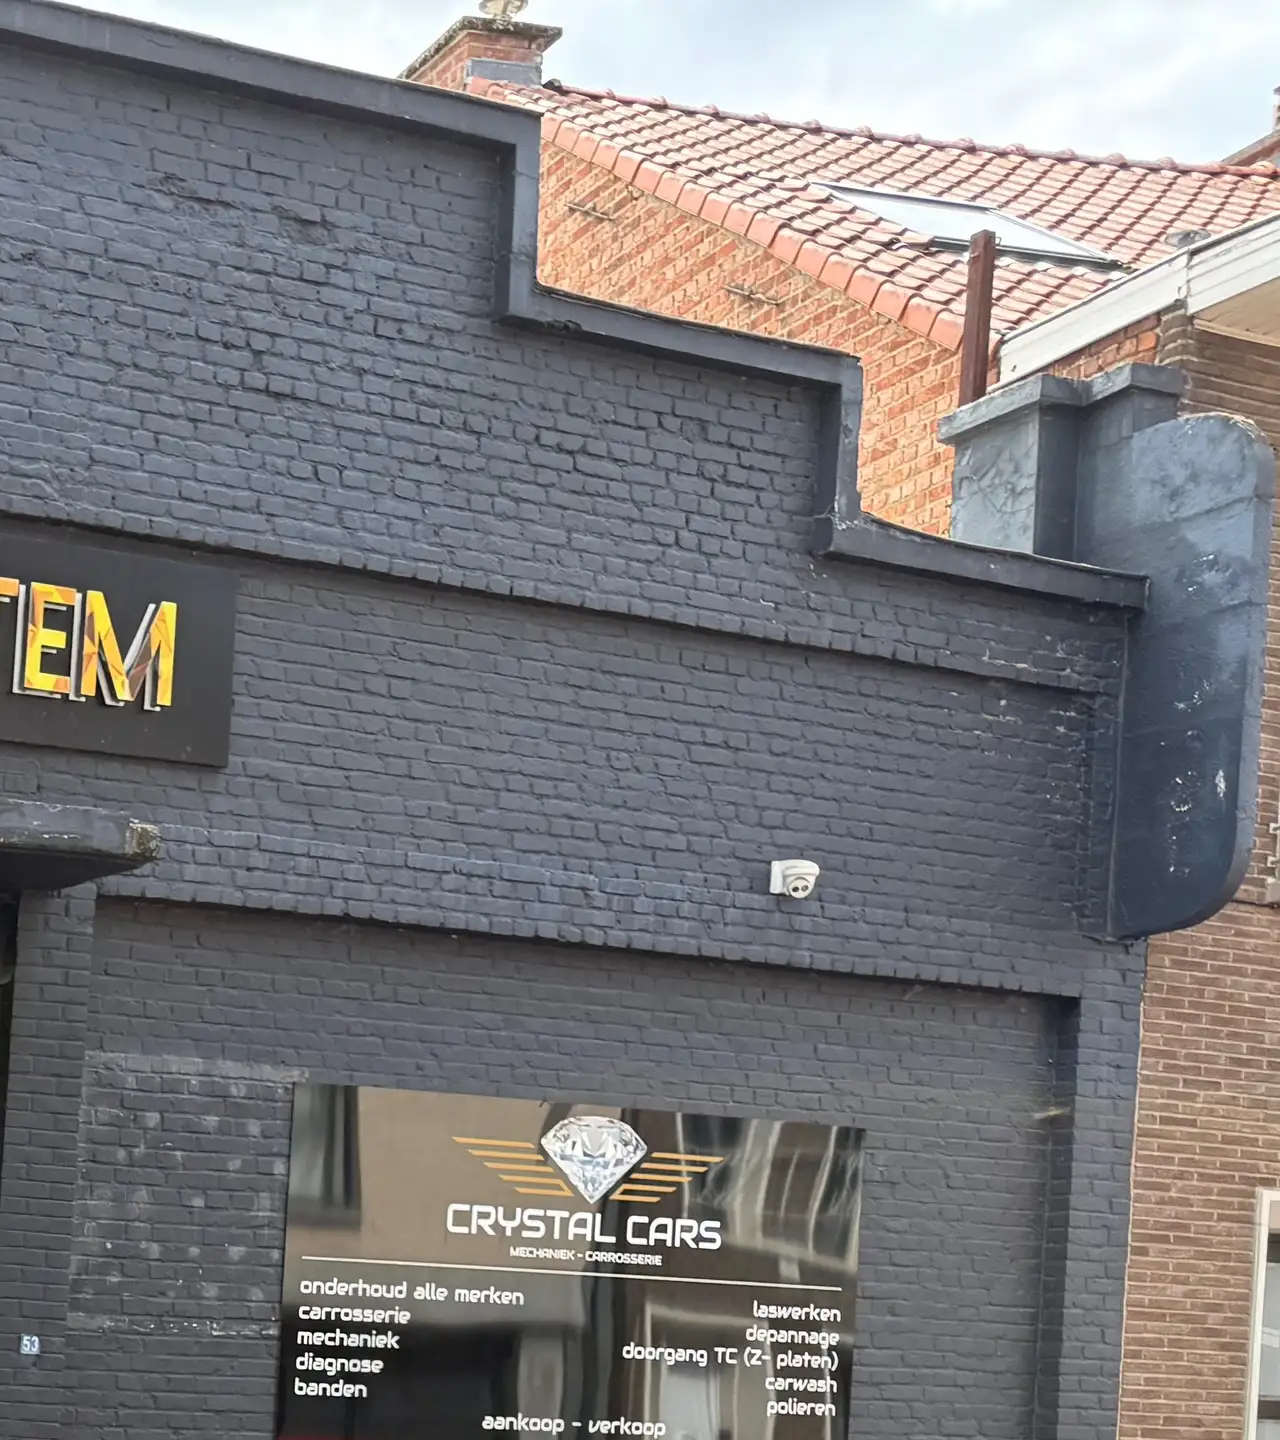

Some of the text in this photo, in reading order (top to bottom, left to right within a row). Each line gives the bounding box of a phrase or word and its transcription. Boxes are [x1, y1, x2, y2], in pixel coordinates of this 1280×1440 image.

[446, 1203, 722, 1250] CRYSTAL CARS
[509, 1246, 575, 1261] MECHANIEK
[585, 1250, 663, 1266] CARROSSERIE
[299, 1278, 524, 1305] onderhoud alle merken
[298, 1305, 411, 1324] carrosserie
[753, 1300, 841, 1322] laswerken
[22, 1335, 40, 1352] 53
[297, 1328, 400, 1349] mechaniek
[746, 1324, 840, 1350] depannage
[295, 1352, 384, 1376] diagnose
[622, 1342, 708, 1367] doorgang
[713, 1346, 738, 1365] TC
[776, 1351, 839, 1371] platen)
[294, 1377, 368, 1398] banden
[764, 1375, 837, 1393] carwash
[766, 1398, 836, 1417] polieren
[482, 1412, 565, 1435] aankoop
[588, 1416, 666, 1439] verkoop
